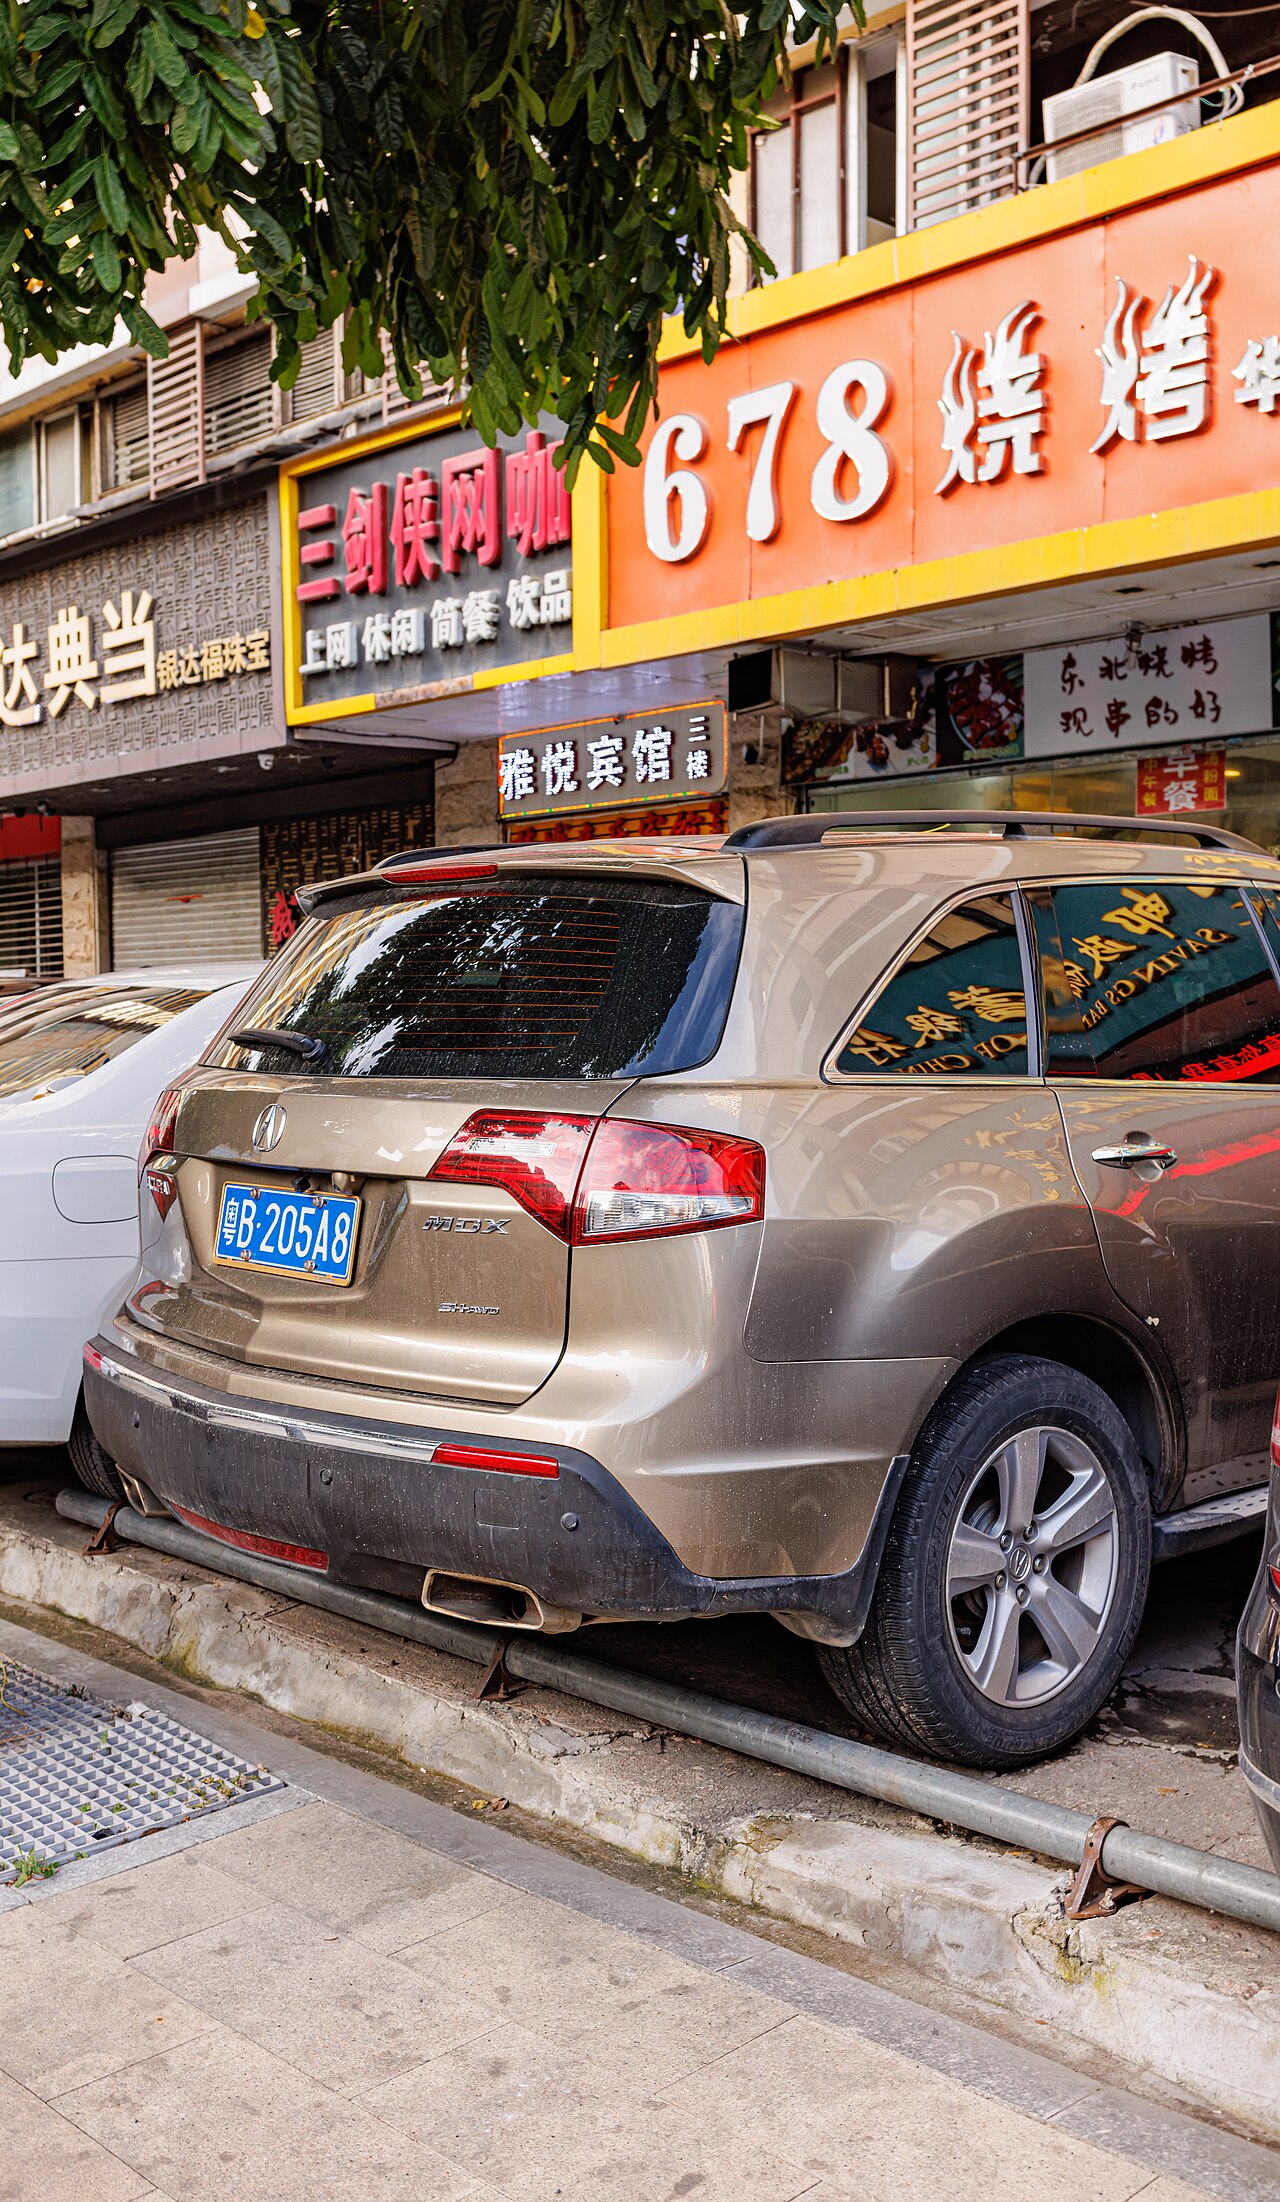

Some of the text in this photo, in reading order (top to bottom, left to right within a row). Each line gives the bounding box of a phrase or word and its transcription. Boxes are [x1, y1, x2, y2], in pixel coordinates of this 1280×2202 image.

[296, 431, 572, 601] 三剑侠网咖
[299, 569, 572, 674] 上网 休闲 简餐 饮品
[156, 628, 271, 690] 银达福珠宝
[1060, 634, 1218, 695] 东北烧烤
[499, 726, 673, 800] 雅悦宾馆
[685, 716, 709, 780] 三楼
[1163, 753, 1199, 811] 早餐
[422, 1215, 512, 1235] MDX
